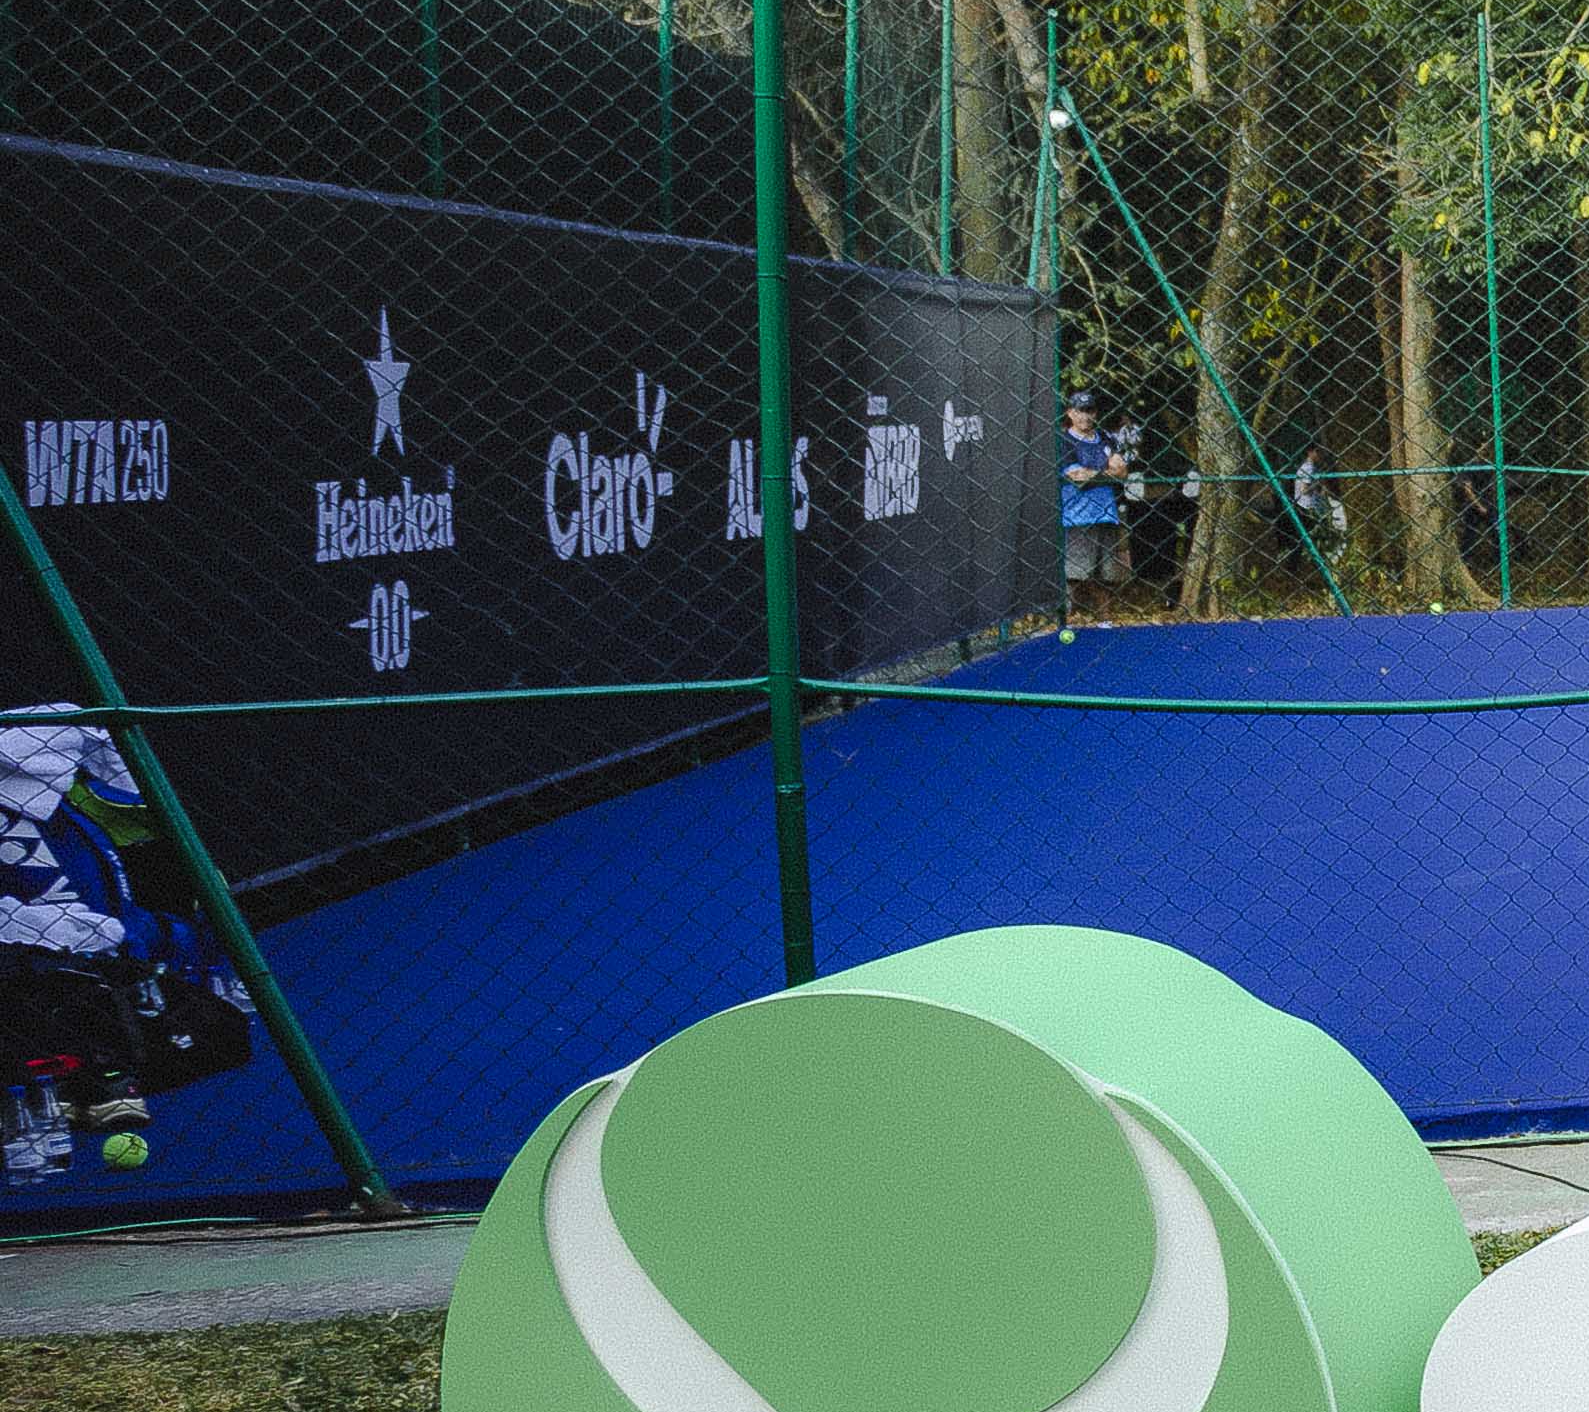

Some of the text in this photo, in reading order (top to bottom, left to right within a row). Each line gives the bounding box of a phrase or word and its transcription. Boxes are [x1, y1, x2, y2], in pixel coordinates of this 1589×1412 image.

[24, 419, 169, 507] WTA 250
[546, 431, 656, 561] Claro
[315, 475, 456, 563] Heineken
[369, 580, 411, 672] 0.0
